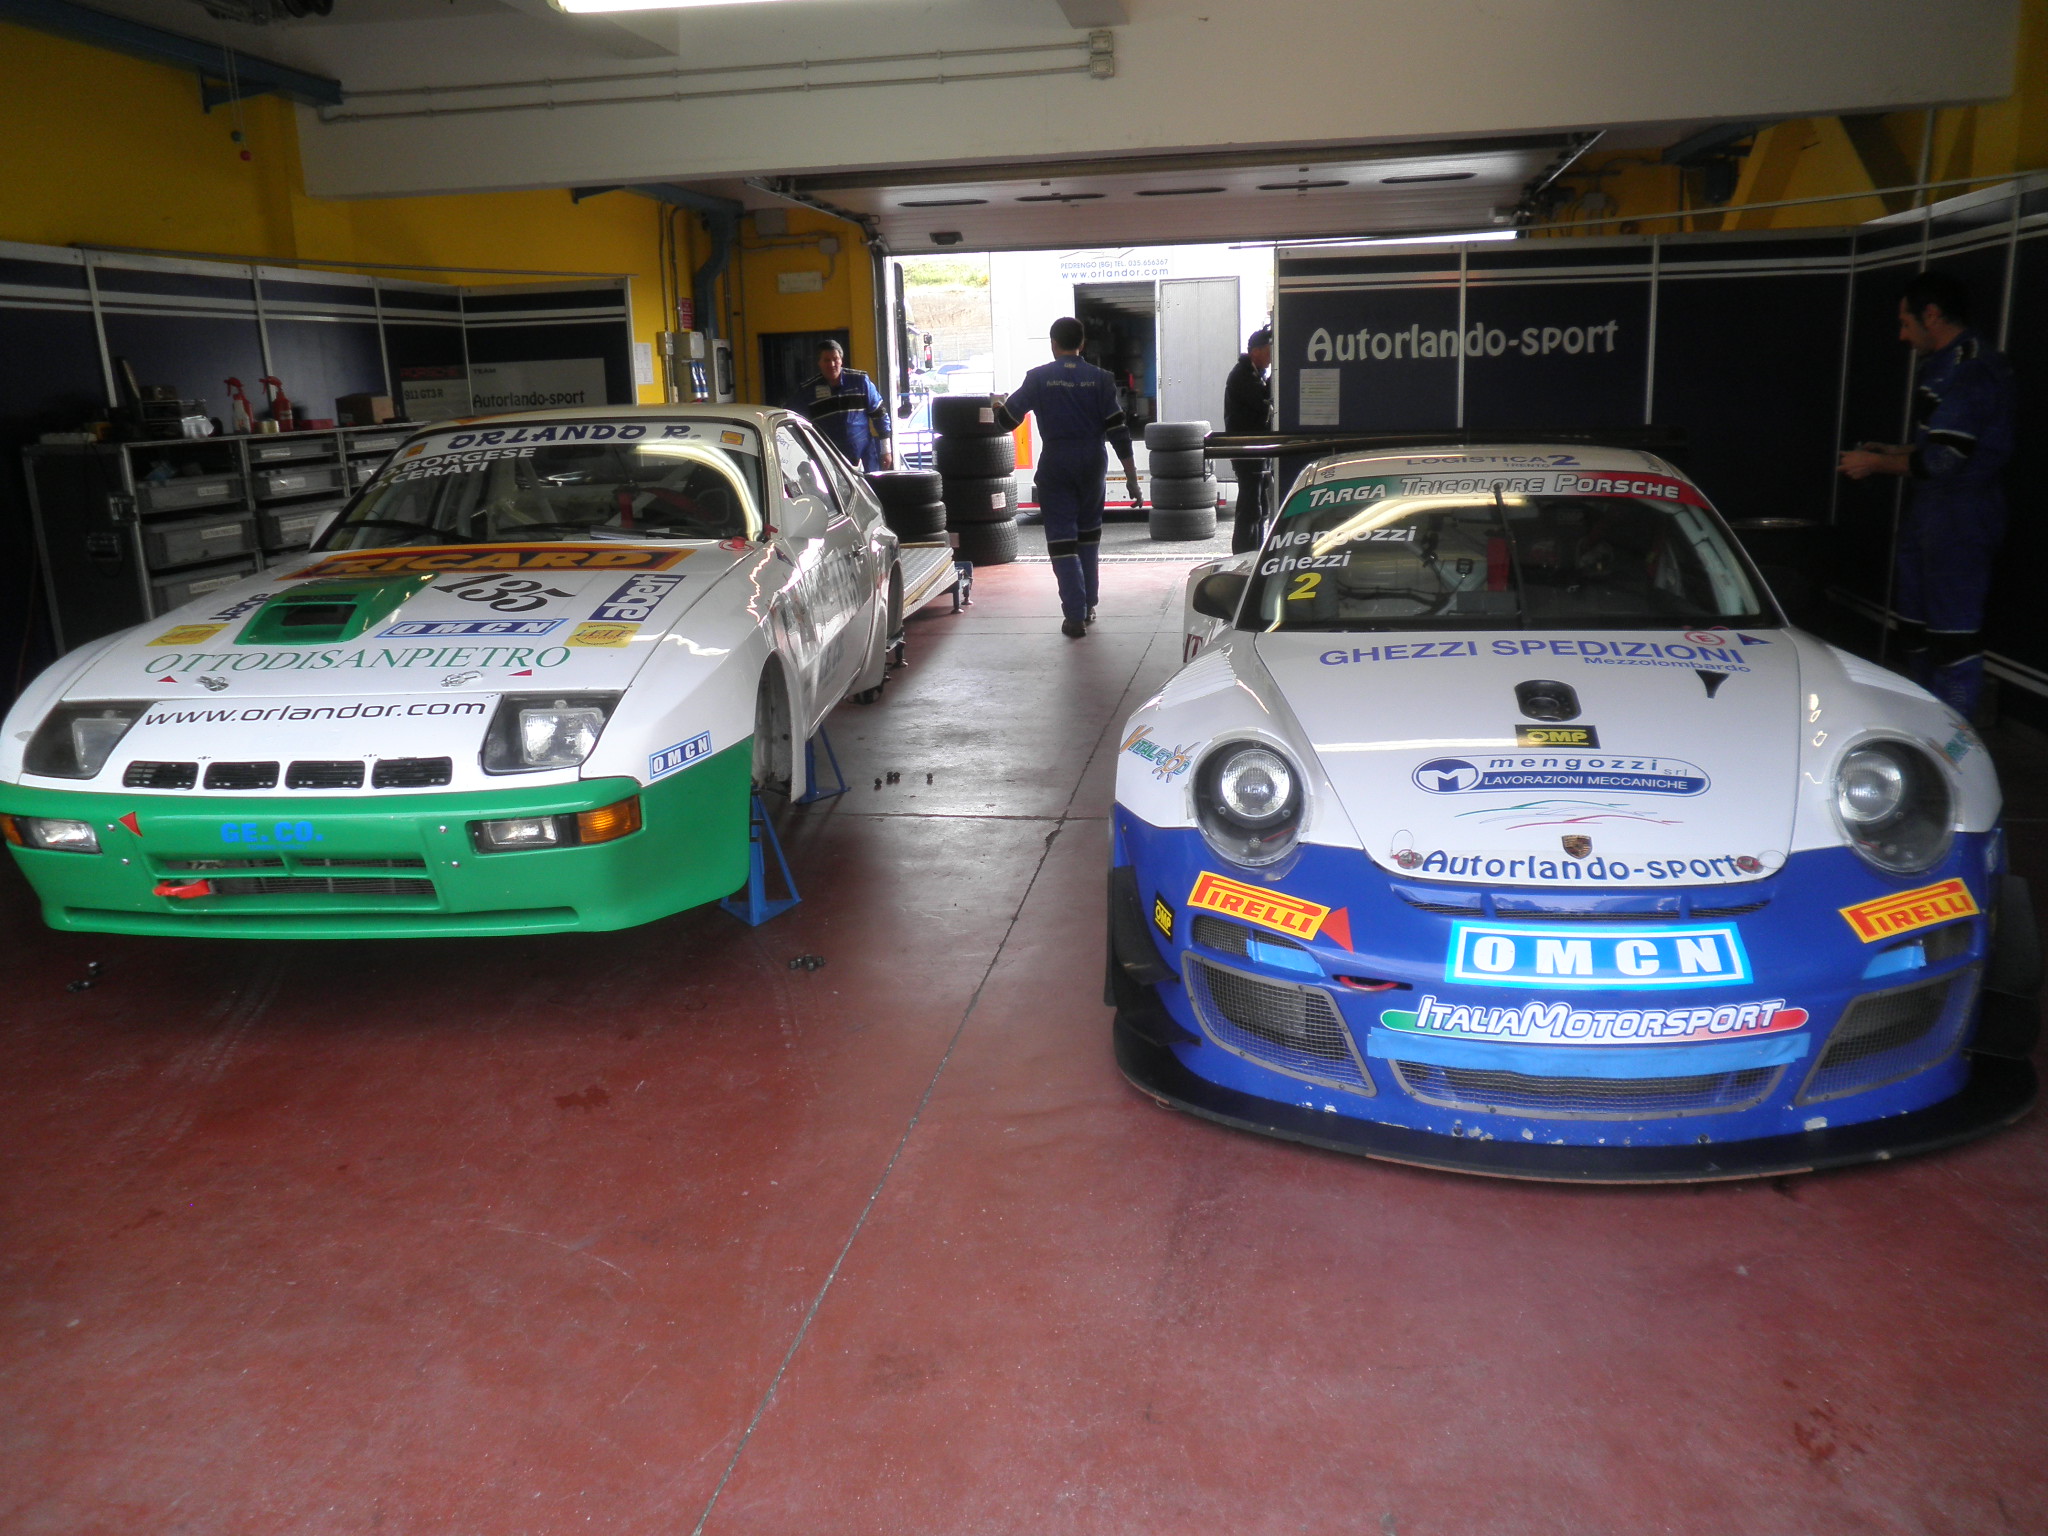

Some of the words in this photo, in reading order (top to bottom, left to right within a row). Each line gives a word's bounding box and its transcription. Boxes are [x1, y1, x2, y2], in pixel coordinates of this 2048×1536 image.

[1060, 262, 1097, 270] PEDRENGO
[1061, 267, 1169, 279] www.orlandor.com
[1307, 319, 1618, 362] Autorlando-sport
[404, 389, 420, 400] 911
[473, 390, 585, 408] Autorlando-sport
[448, 425, 646, 449] ORLANDO
[661, 424, 702, 438] R.
[1309, 482, 1386, 507] TARGA
[1401, 477, 1545, 496] TRICOLORE
[1555, 474, 1679, 499] PORSCHE
[1270, 526, 1417, 552] Mengozzi
[325, 552, 655, 573] RICARD
[1260, 551, 1352, 576] Ghezzi
[432, 574, 576, 612] 135
[1287, 573, 1320, 601] 2
[388, 620, 556, 635] OMCN
[144, 645, 571, 674] OTTODISANPIETRO
[1320, 643, 1477, 667] GHEZZI
[1492, 640, 1745, 664] SPEDIZIONI
[1584, 657, 1751, 673] Mezzolombardo
[146, 700, 486, 725] www.orlandor.com
[1527, 731, 1588, 743] OMP
[652, 738, 710, 771] OMCN
[1489, 758, 1658, 771] mengozzi
[1664, 767, 1688, 776] srl
[1484, 775, 1583, 786] LAVORAZIONI
[1588, 776, 1688, 790] MECCANICHE
[1423, 850, 1738, 880] Autorlando-sport
[1155, 904, 1172, 929] OMP
[1192, 875, 1322, 933] PIRELLI
[1848, 881, 1974, 938] PIRELLI
[1473, 938, 1723, 978] OMCN
[1416, 998, 1785, 1045] ITALIAMOTORSPORT
